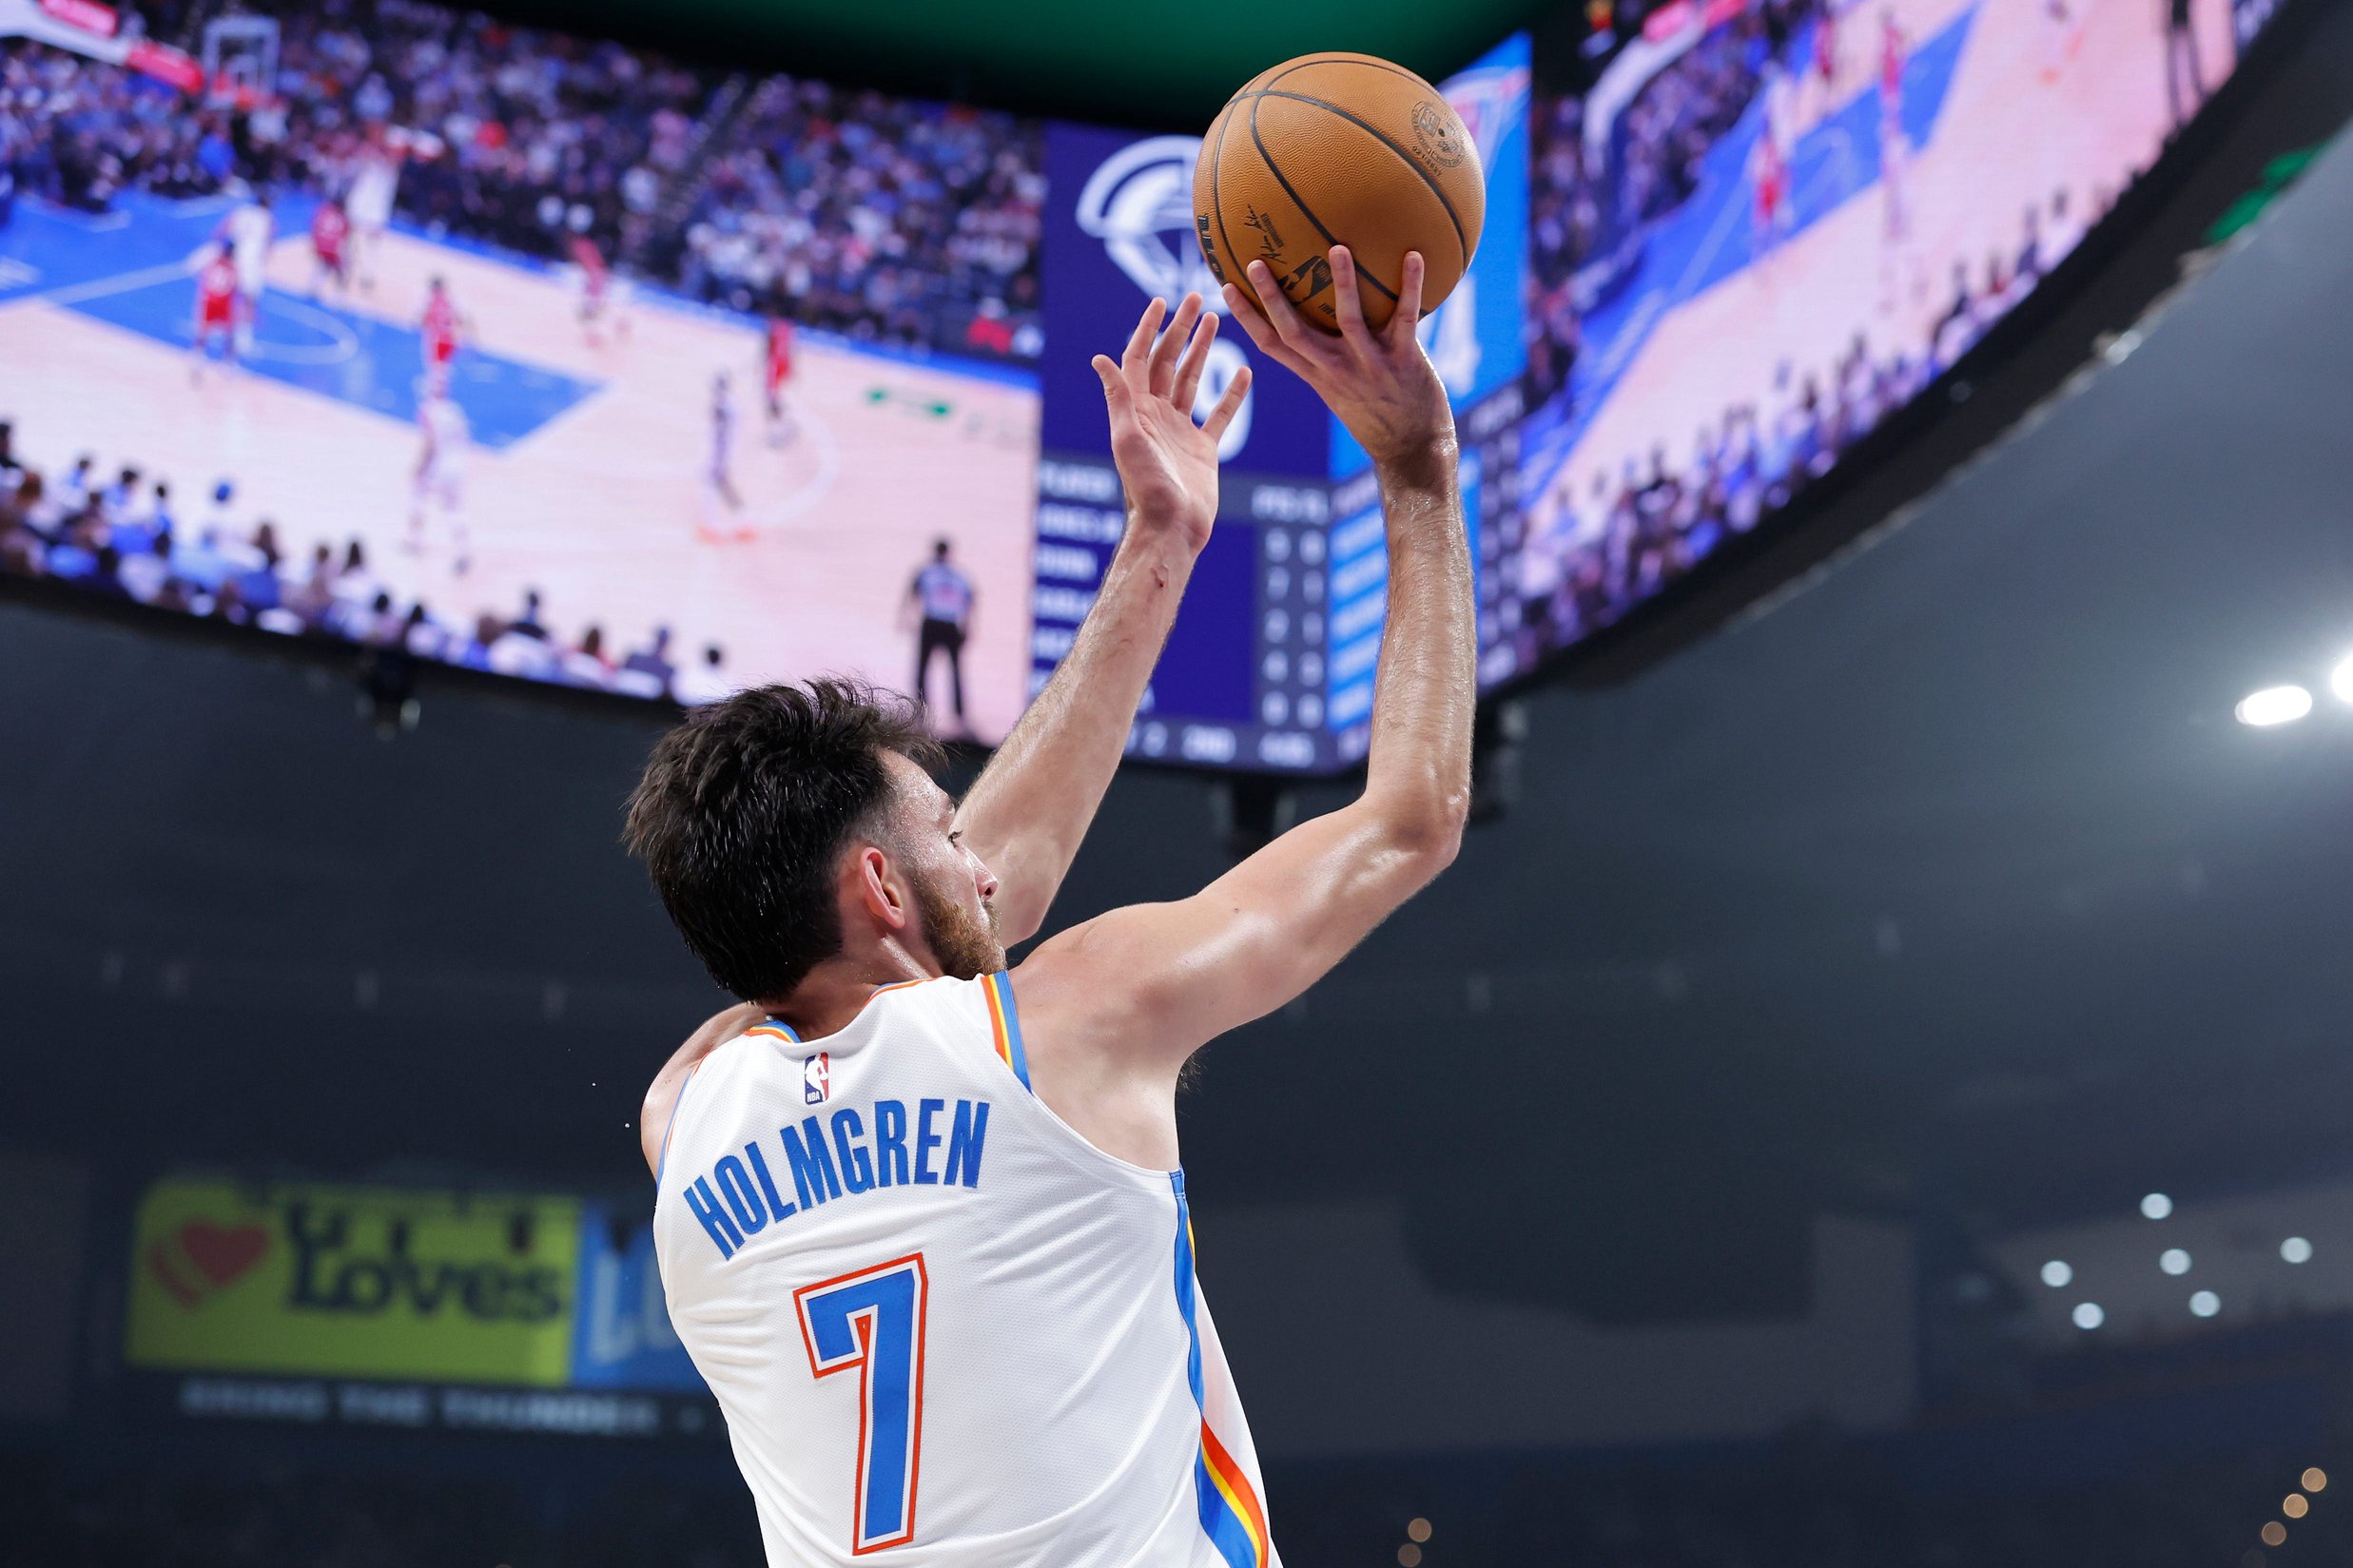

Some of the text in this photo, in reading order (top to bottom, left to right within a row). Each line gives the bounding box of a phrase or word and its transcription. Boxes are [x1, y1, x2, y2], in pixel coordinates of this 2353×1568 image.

[807, 1091, 820, 1103] NBA
[683, 1098, 990, 1261] HOLMGREN
[792, 1252, 928, 1556] 7
